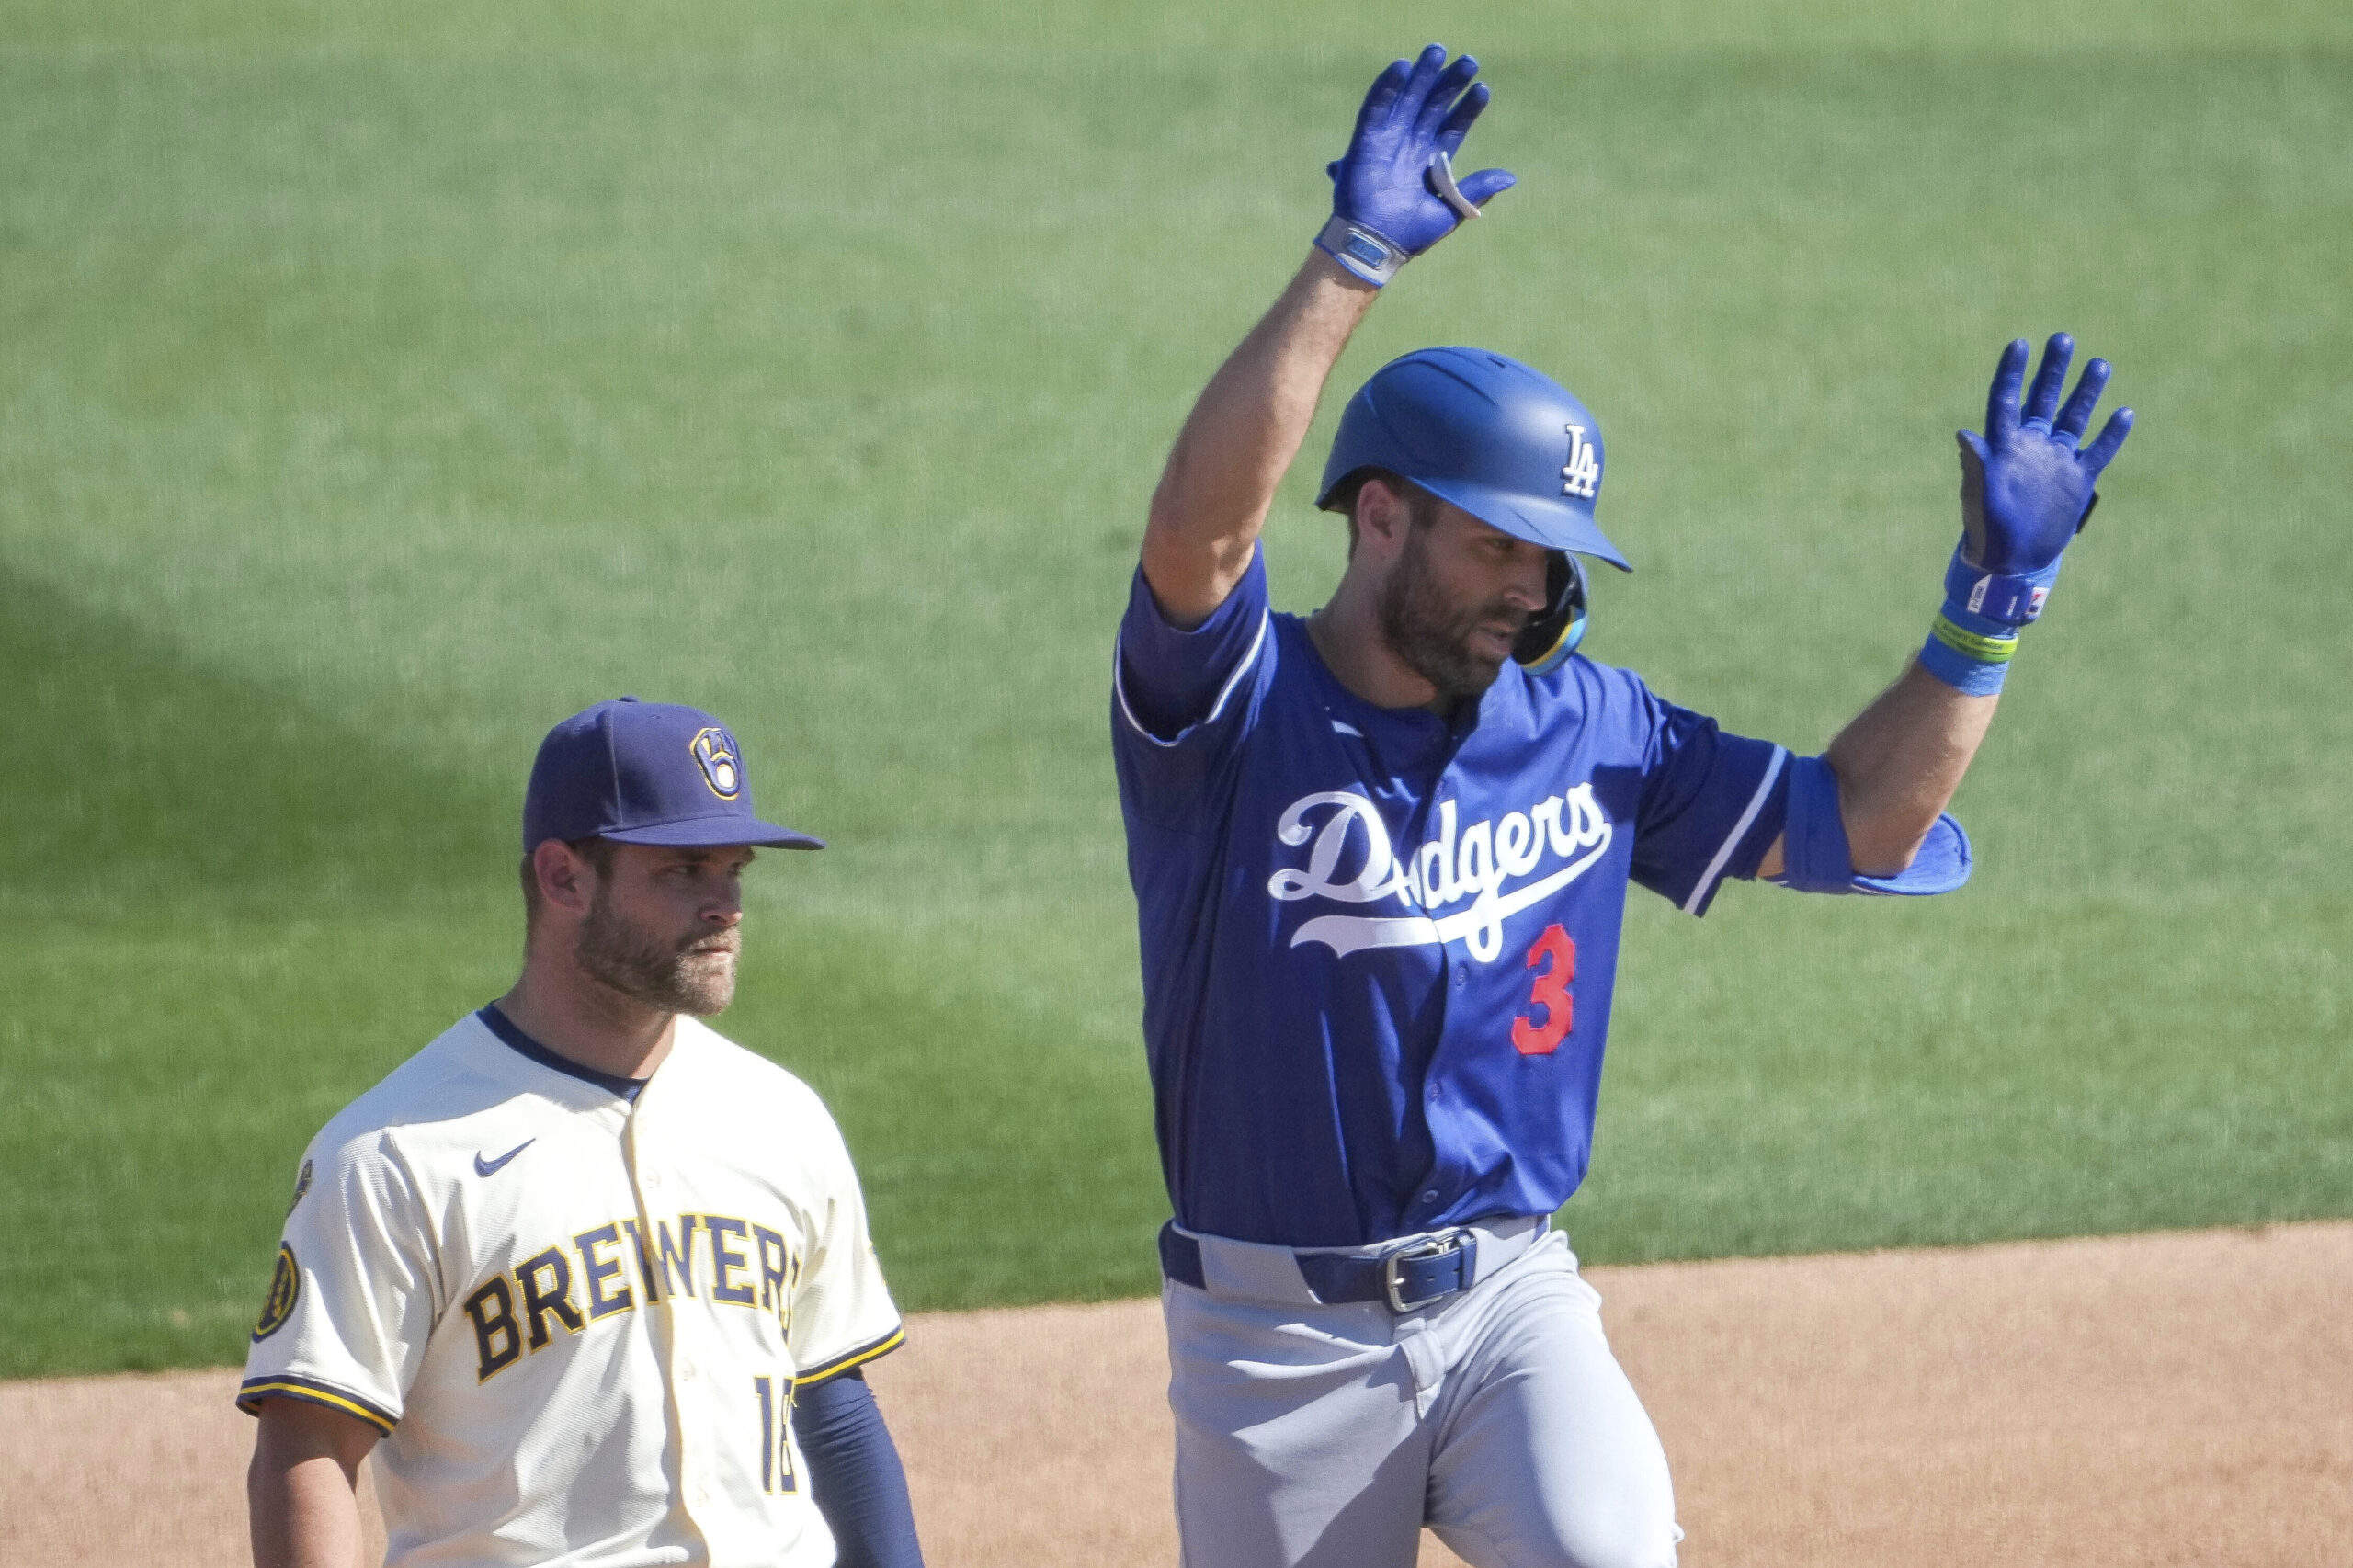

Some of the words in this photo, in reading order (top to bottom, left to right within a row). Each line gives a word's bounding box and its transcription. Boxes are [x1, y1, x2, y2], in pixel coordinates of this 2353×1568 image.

[1563, 424, 1598, 497] LA
[1267, 781, 1612, 963] Dodgers
[1511, 923, 1576, 1055] 3
